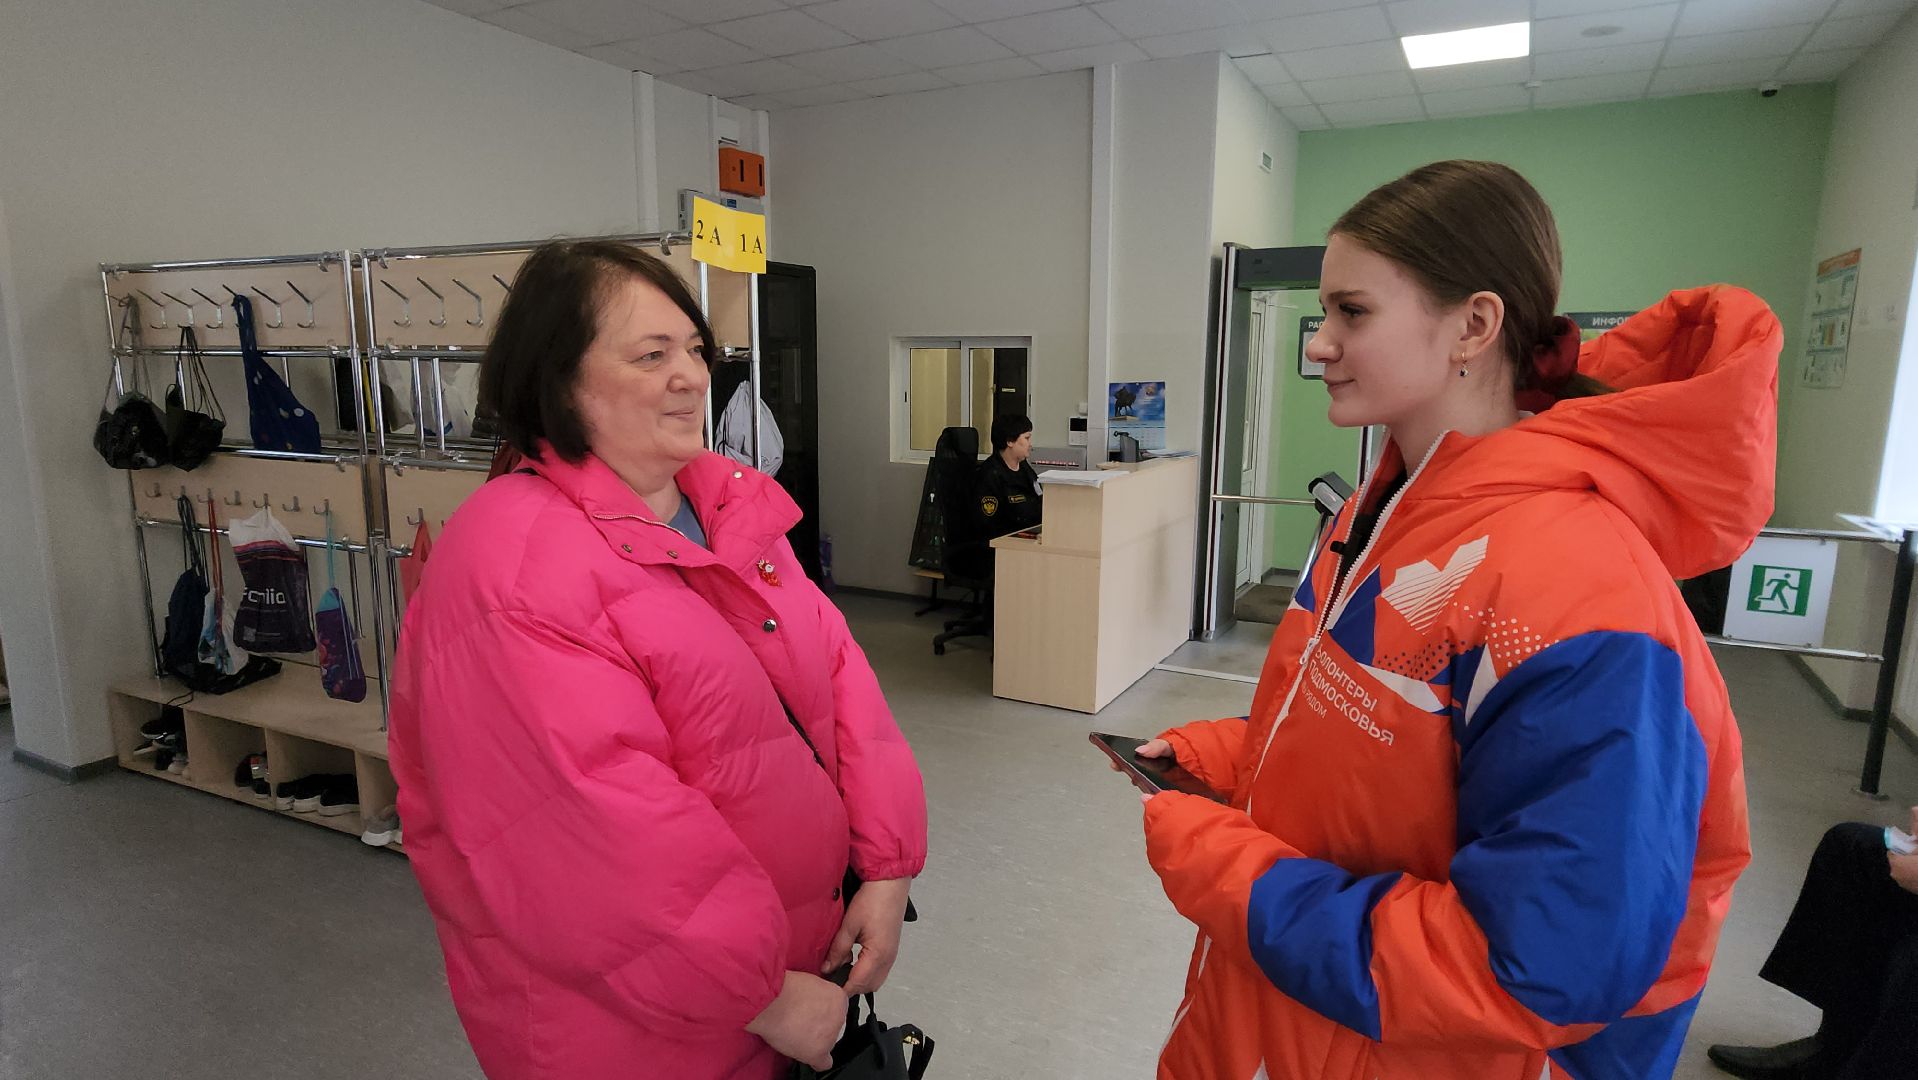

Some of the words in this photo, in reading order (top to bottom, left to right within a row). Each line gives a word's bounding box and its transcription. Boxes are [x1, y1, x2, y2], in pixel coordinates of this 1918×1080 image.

[696, 220, 704, 239] 2
[740, 234, 747, 252] 1
[1309, 659, 1394, 746] ПОДМОСКОВЬЯ
